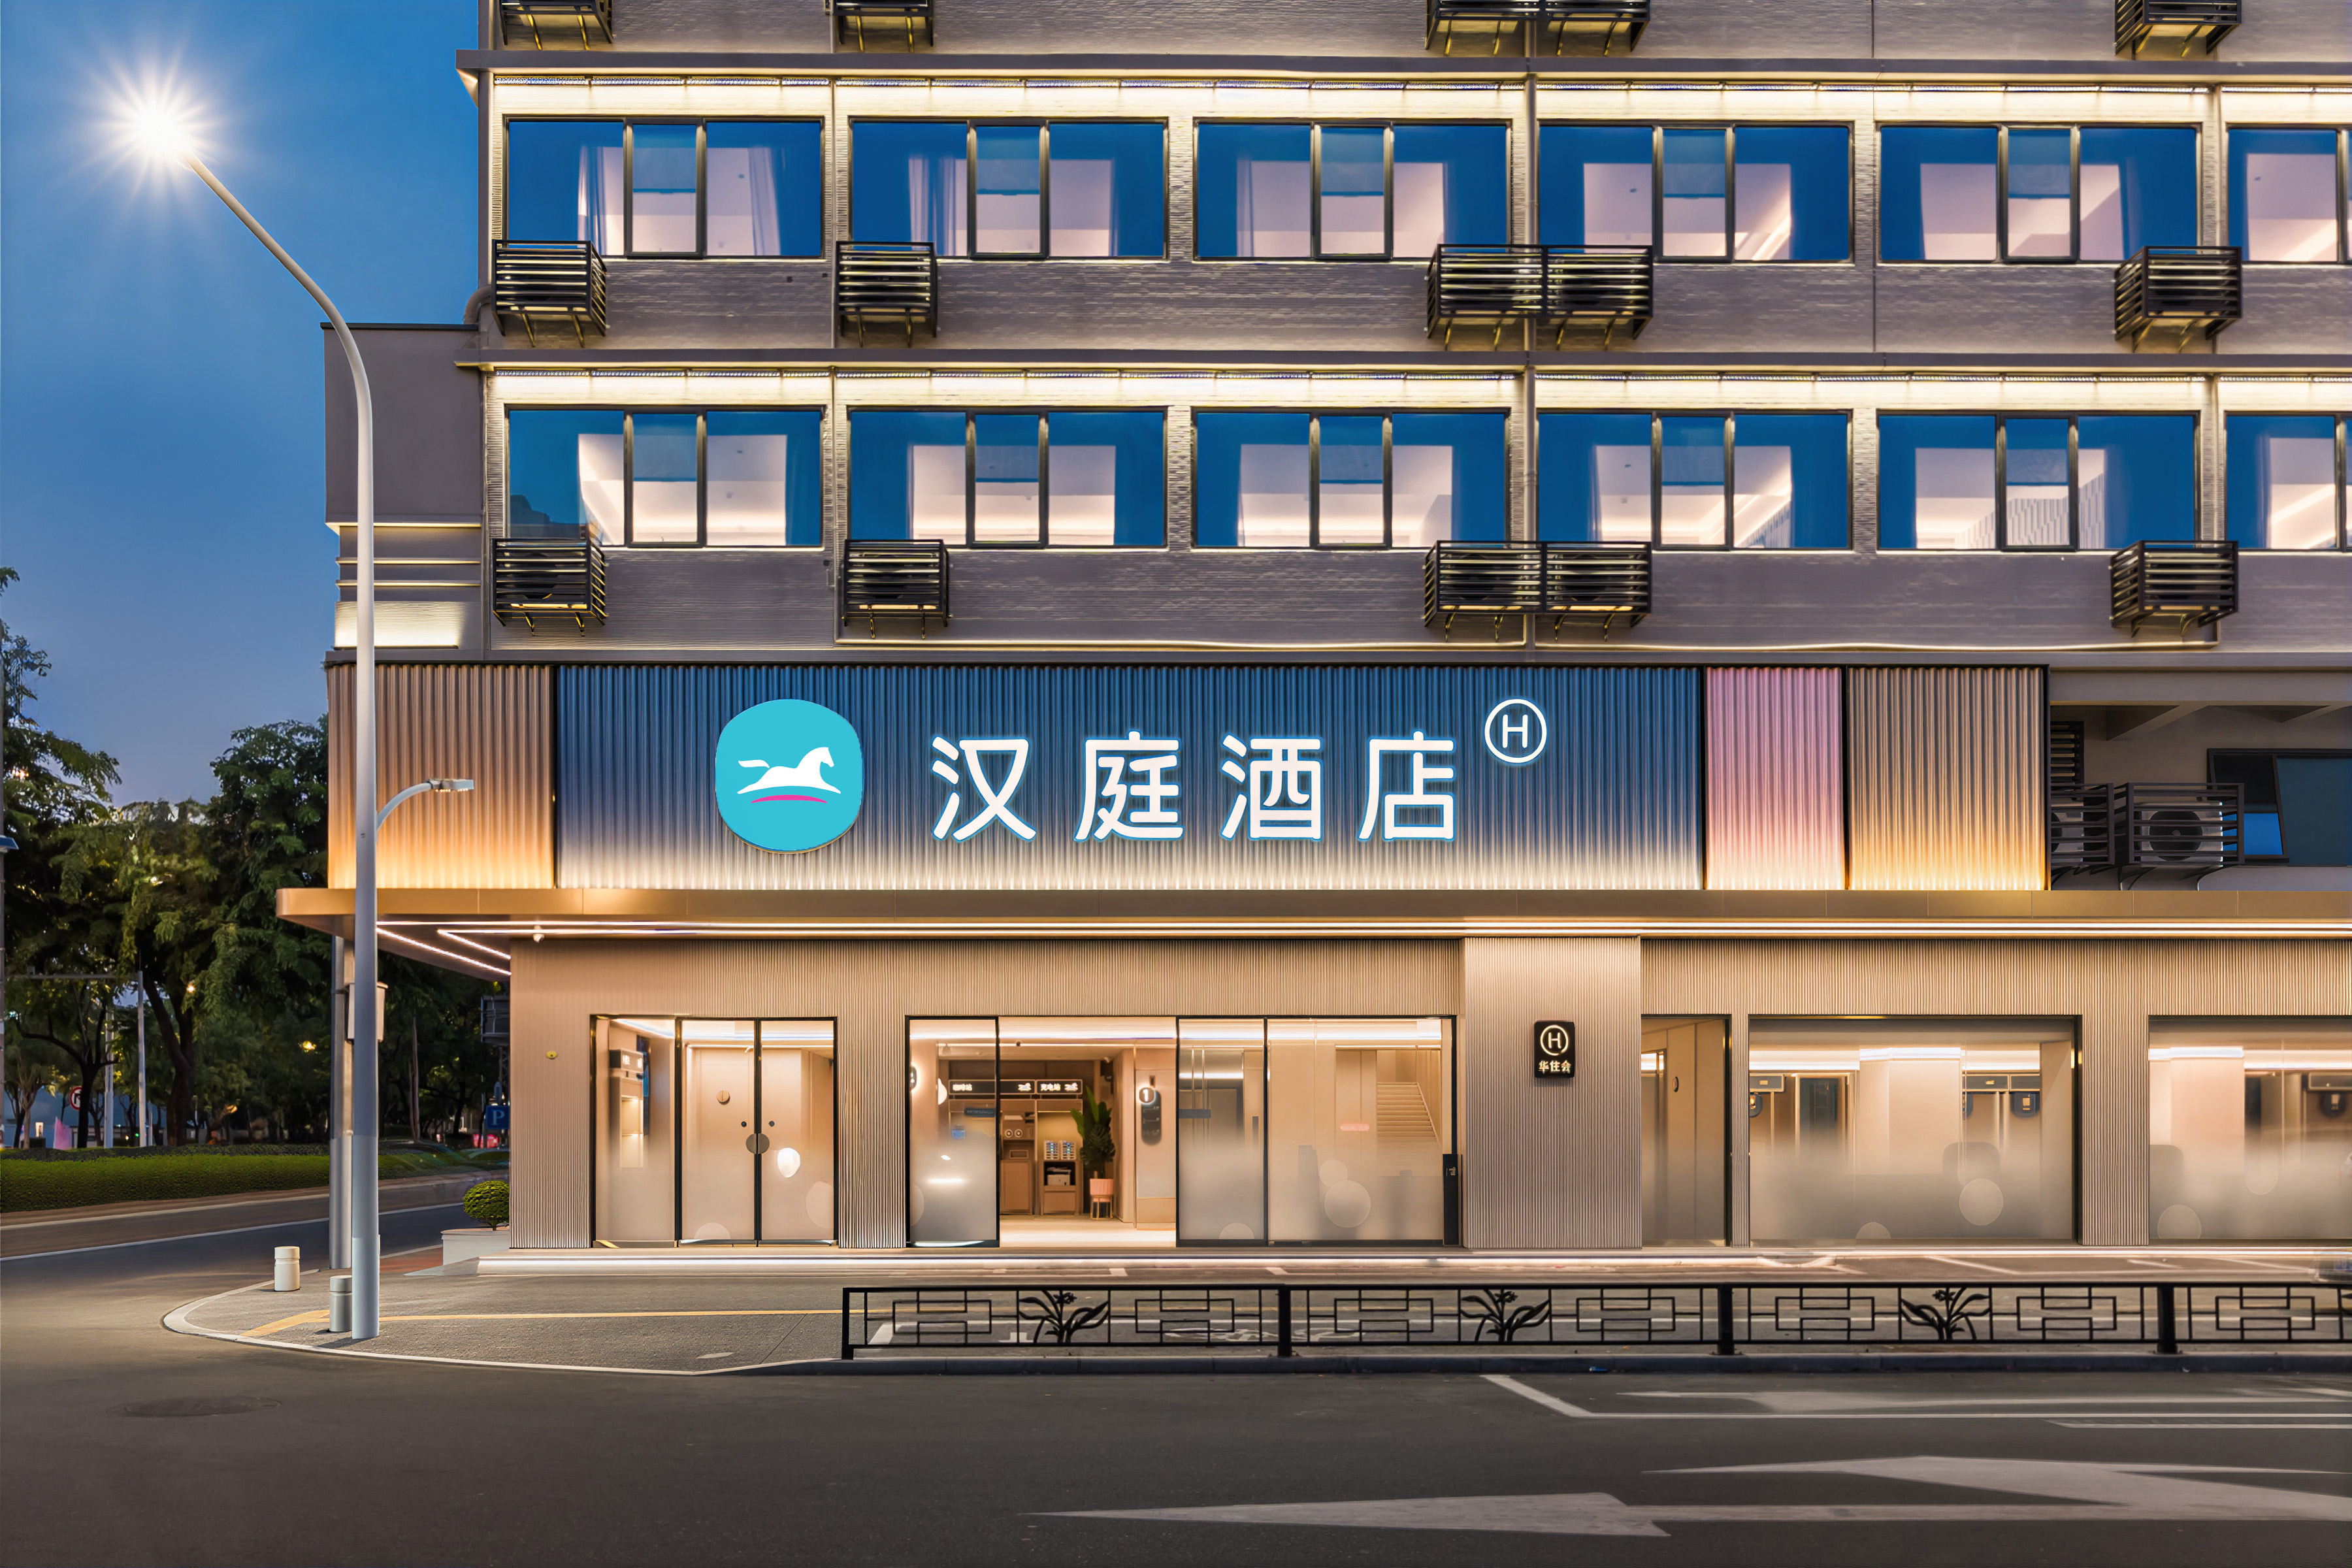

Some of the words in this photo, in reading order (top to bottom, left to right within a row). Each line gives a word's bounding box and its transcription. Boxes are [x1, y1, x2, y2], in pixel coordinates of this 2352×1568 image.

[932, 731, 1454, 840] 汉庭酒店
[1539, 1060, 1571, 1073] 华住会
[1143, 1088, 1149, 1102] 1
[491, 1109, 505, 1126] P
